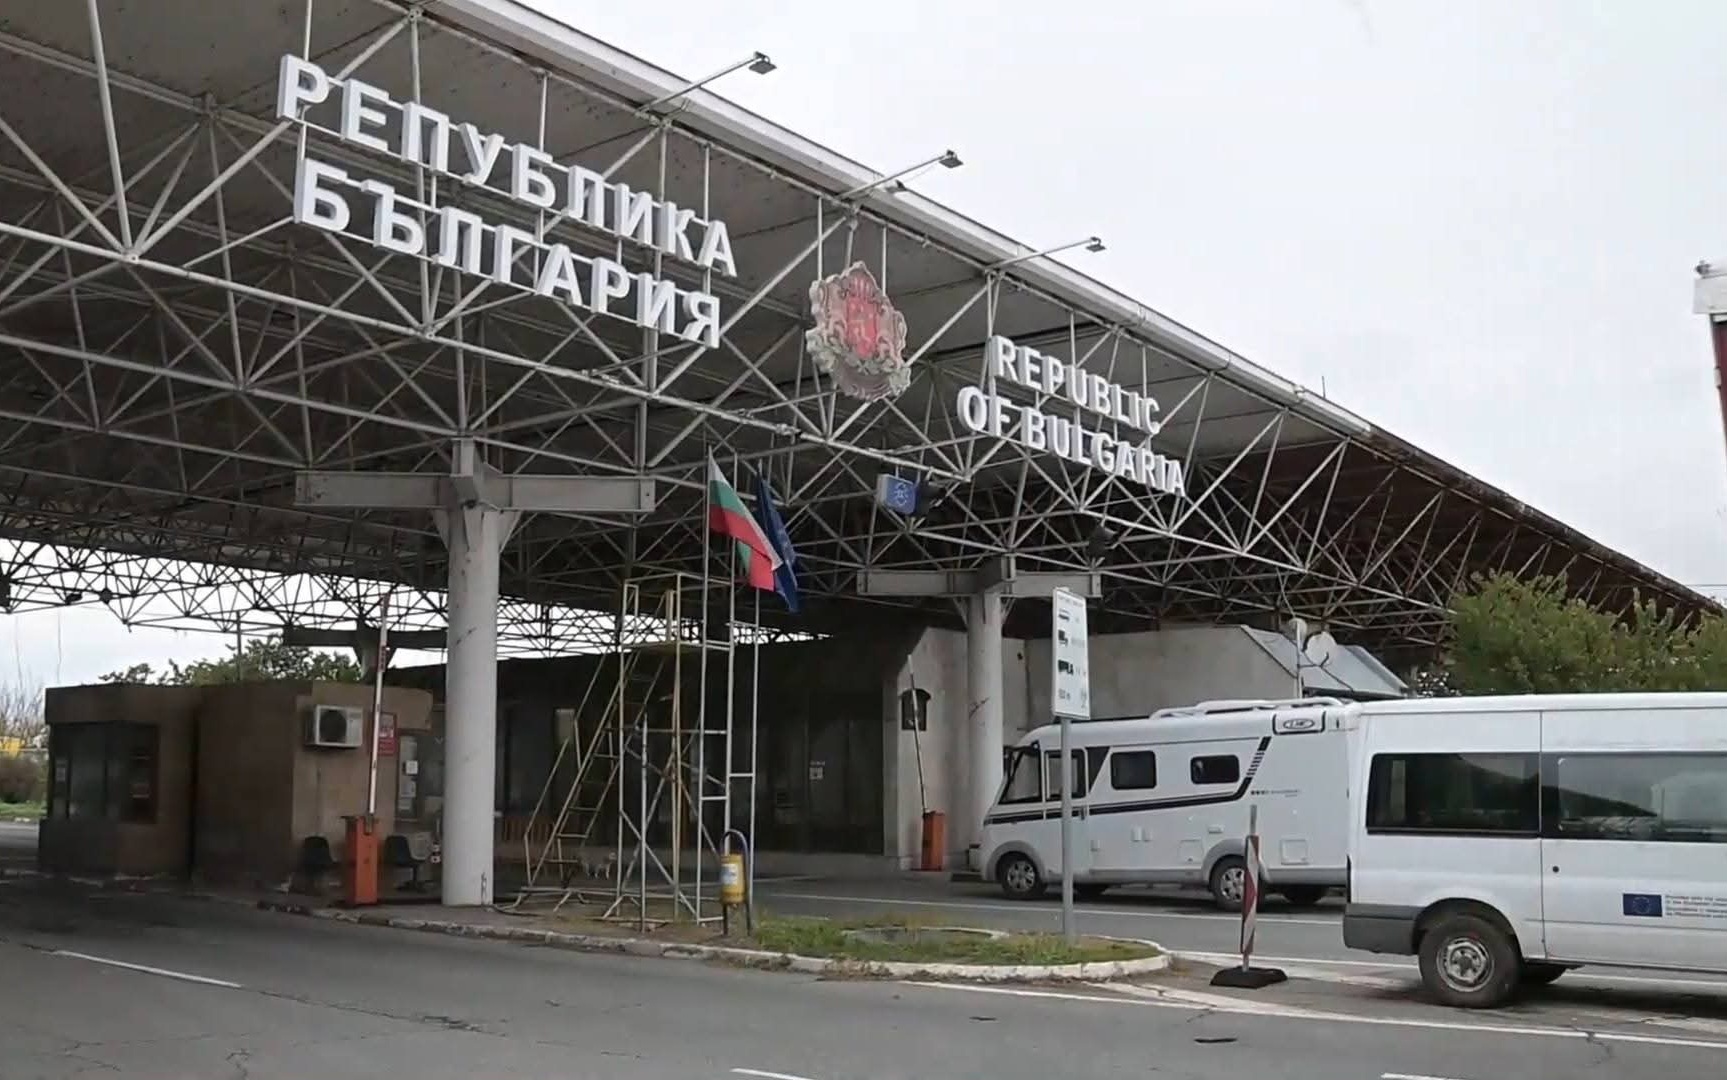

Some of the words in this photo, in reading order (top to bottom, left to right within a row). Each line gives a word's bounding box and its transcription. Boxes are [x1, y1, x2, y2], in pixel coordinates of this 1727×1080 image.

[276, 54, 738, 278] РЕПУБЛИКА
[293, 159, 721, 349] БЪЛГАРИЯ
[956, 386, 1011, 437] OF
[1020, 407, 1185, 497] BULGARIA
[989, 335, 1160, 435] REPUBLIC
